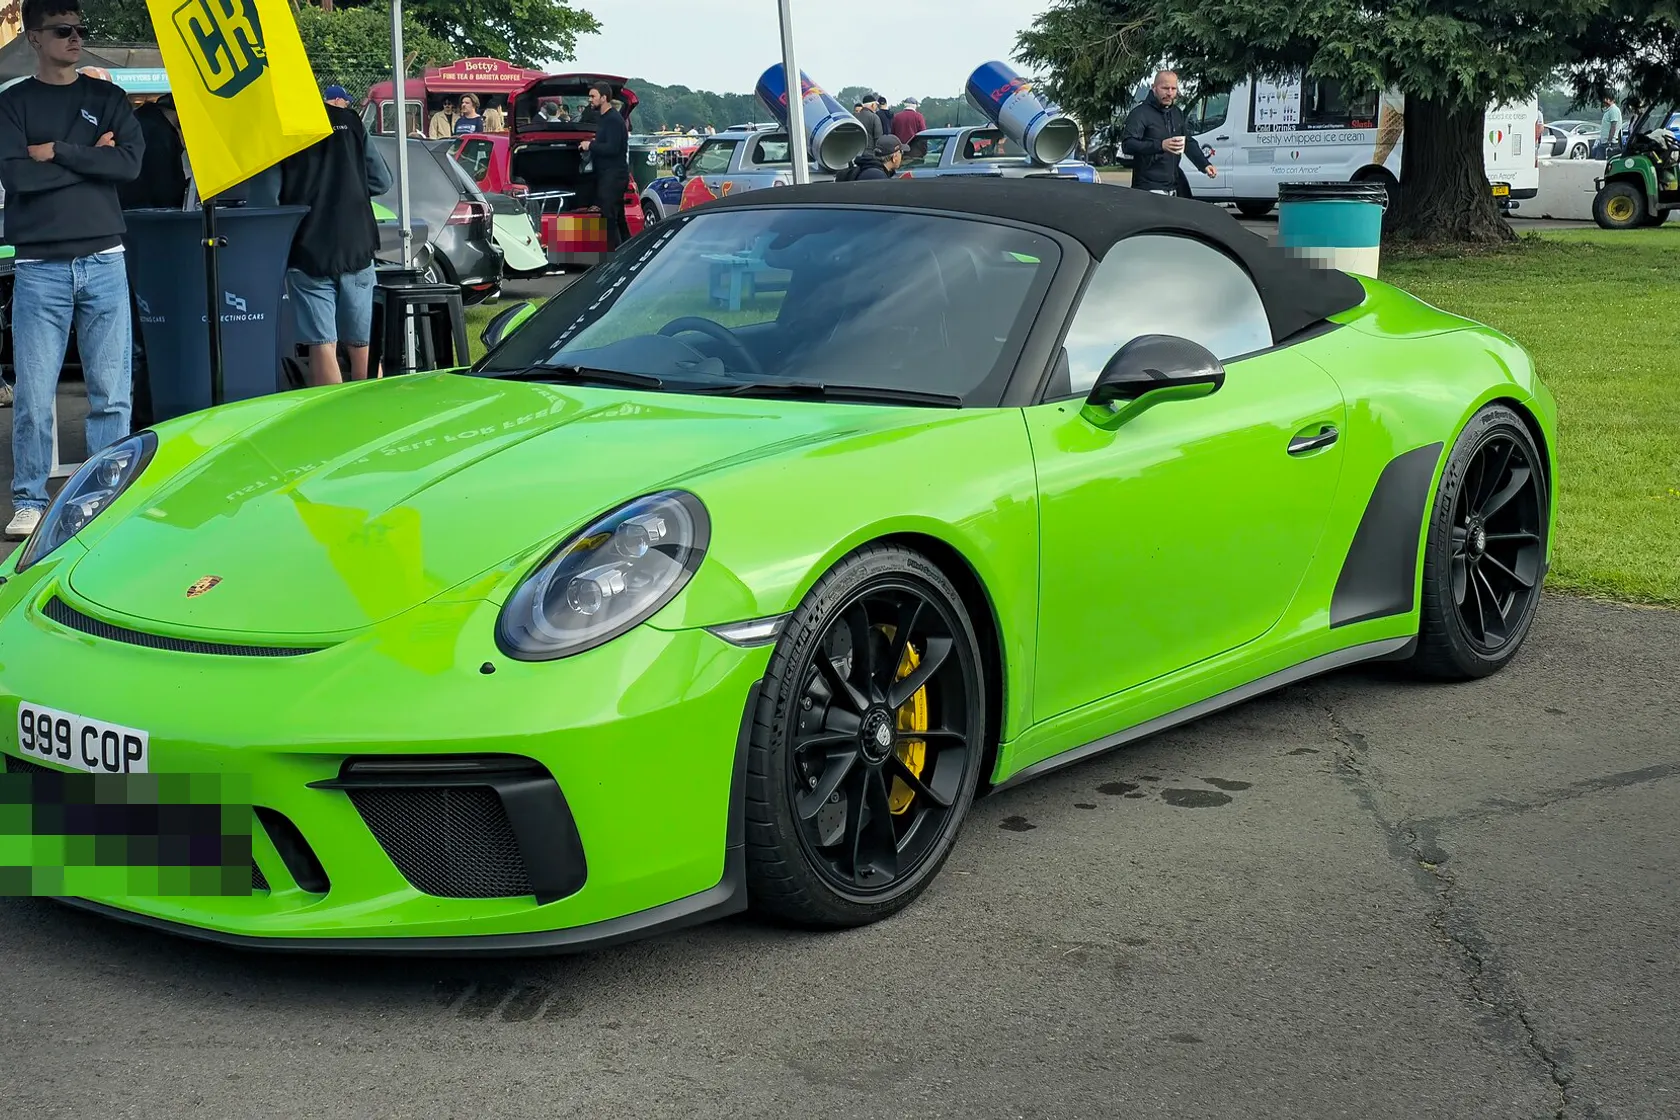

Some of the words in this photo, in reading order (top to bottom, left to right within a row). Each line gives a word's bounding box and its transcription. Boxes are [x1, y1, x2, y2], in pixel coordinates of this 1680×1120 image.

[465, 61, 498, 73] Betty's
[1273, 124, 1296, 132] Drinks
[1256, 133, 1282, 145] freshly
[1283, 132, 1321, 144] whipped
[1323, 132, 1336, 142] ice
[1338, 132, 1365, 142] cream
[247, 313, 264, 321] CARS
[779, 625, 810, 699] MICHELIN
[20, 709, 72, 761] 999
[81, 725, 143, 773] COP
